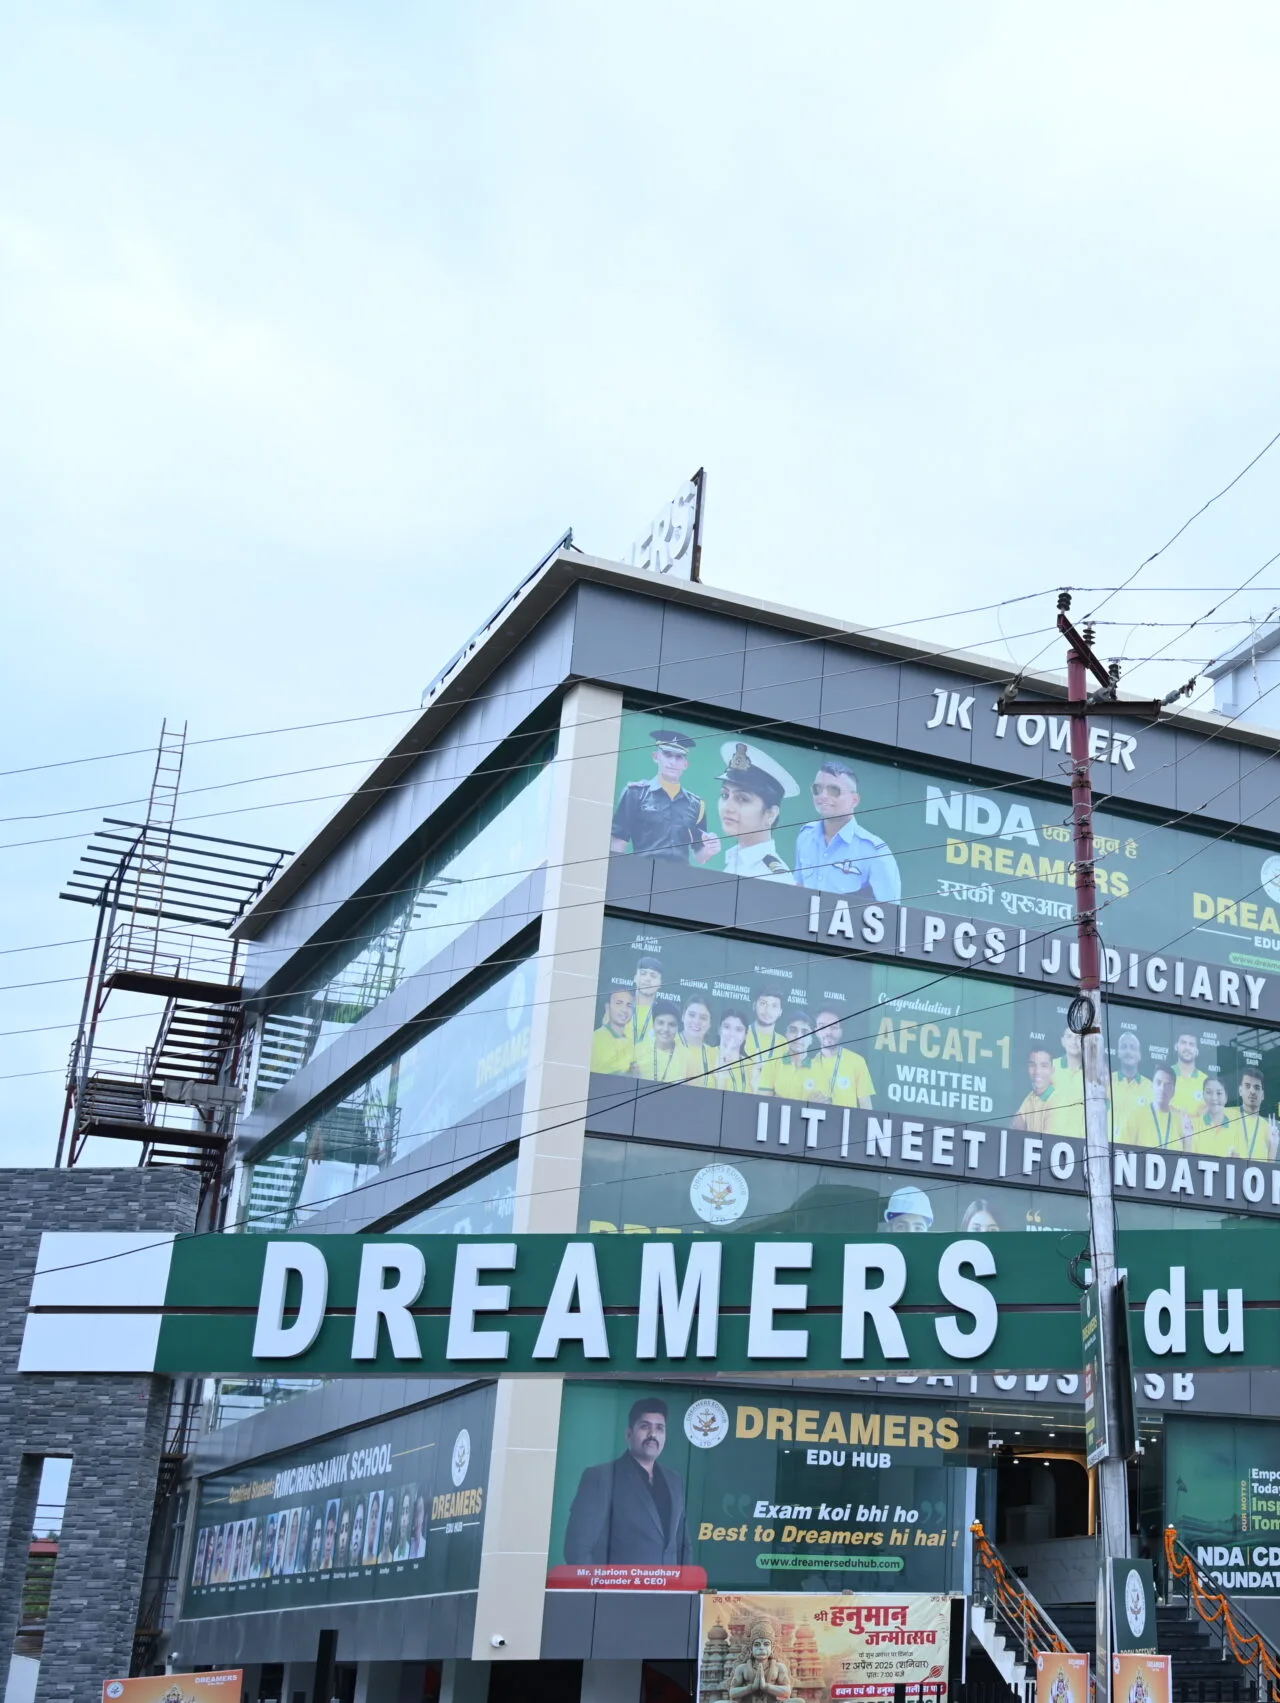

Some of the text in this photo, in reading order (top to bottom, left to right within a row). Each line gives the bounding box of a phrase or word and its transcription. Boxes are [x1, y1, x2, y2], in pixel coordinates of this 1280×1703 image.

[926, 688, 975, 730] JK
[925, 785, 1040, 848] NDA
[1042, 824, 1071, 843] एक
[1124, 838, 1138, 859] है
[808, 895, 885, 944] IAS
[923, 915, 1006, 964] PCS
[1254, 935, 1280, 952] EDU
[611, 977, 634, 987] KESHAV
[874, 1017, 1010, 1069] AFCAT-1
[1030, 1032, 1046, 1041] AJAY
[896, 1063, 986, 1092] WRITTEN
[887, 1084, 993, 1113] QUALIFIED
[756, 1102, 826, 1148] IIT
[866, 1117, 985, 1169] NEET
[251, 1239, 998, 1361] DREAMERS
[736, 1406, 959, 1450] DREAMERS
[350, 1443, 392, 1481] SCHOOL
[806, 1449, 891, 1469] EDU HUB
[431, 1487, 482, 1521] DREAMERS
[753, 1500, 919, 1524] Exam koi bhi ho
[698, 1522, 748, 1542] Best
[753, 1526, 774, 1543] to
[781, 1525, 883, 1546] Dreamers
[889, 1527, 910, 1547] hi
[913, 1527, 946, 1547] hai
[760, 1556, 901, 1570] www.dreamerseduhub.com
[1197, 1546, 1245, 1567] NDA
[577, 1568, 681, 1578] Mr. Hariom Chaudhary
[590, 1577, 631, 1585] (Founder
[643, 1577, 667, 1586] CEO)
[814, 1606, 909, 1635] श्री हनुमान
[865, 1625, 938, 1646] जन्मोत्सव
[841, 1662, 851, 1670] 12
[875, 1661, 894, 1670] 2025
[896, 1659, 929, 1669] (शनिवार)
[194, 1674, 238, 1684] DREAMERS
[835, 1687, 852, 1696] हवन
[865, 1686, 875, 1695] श्री
[877, 1686, 896, 1697] हनुमा
